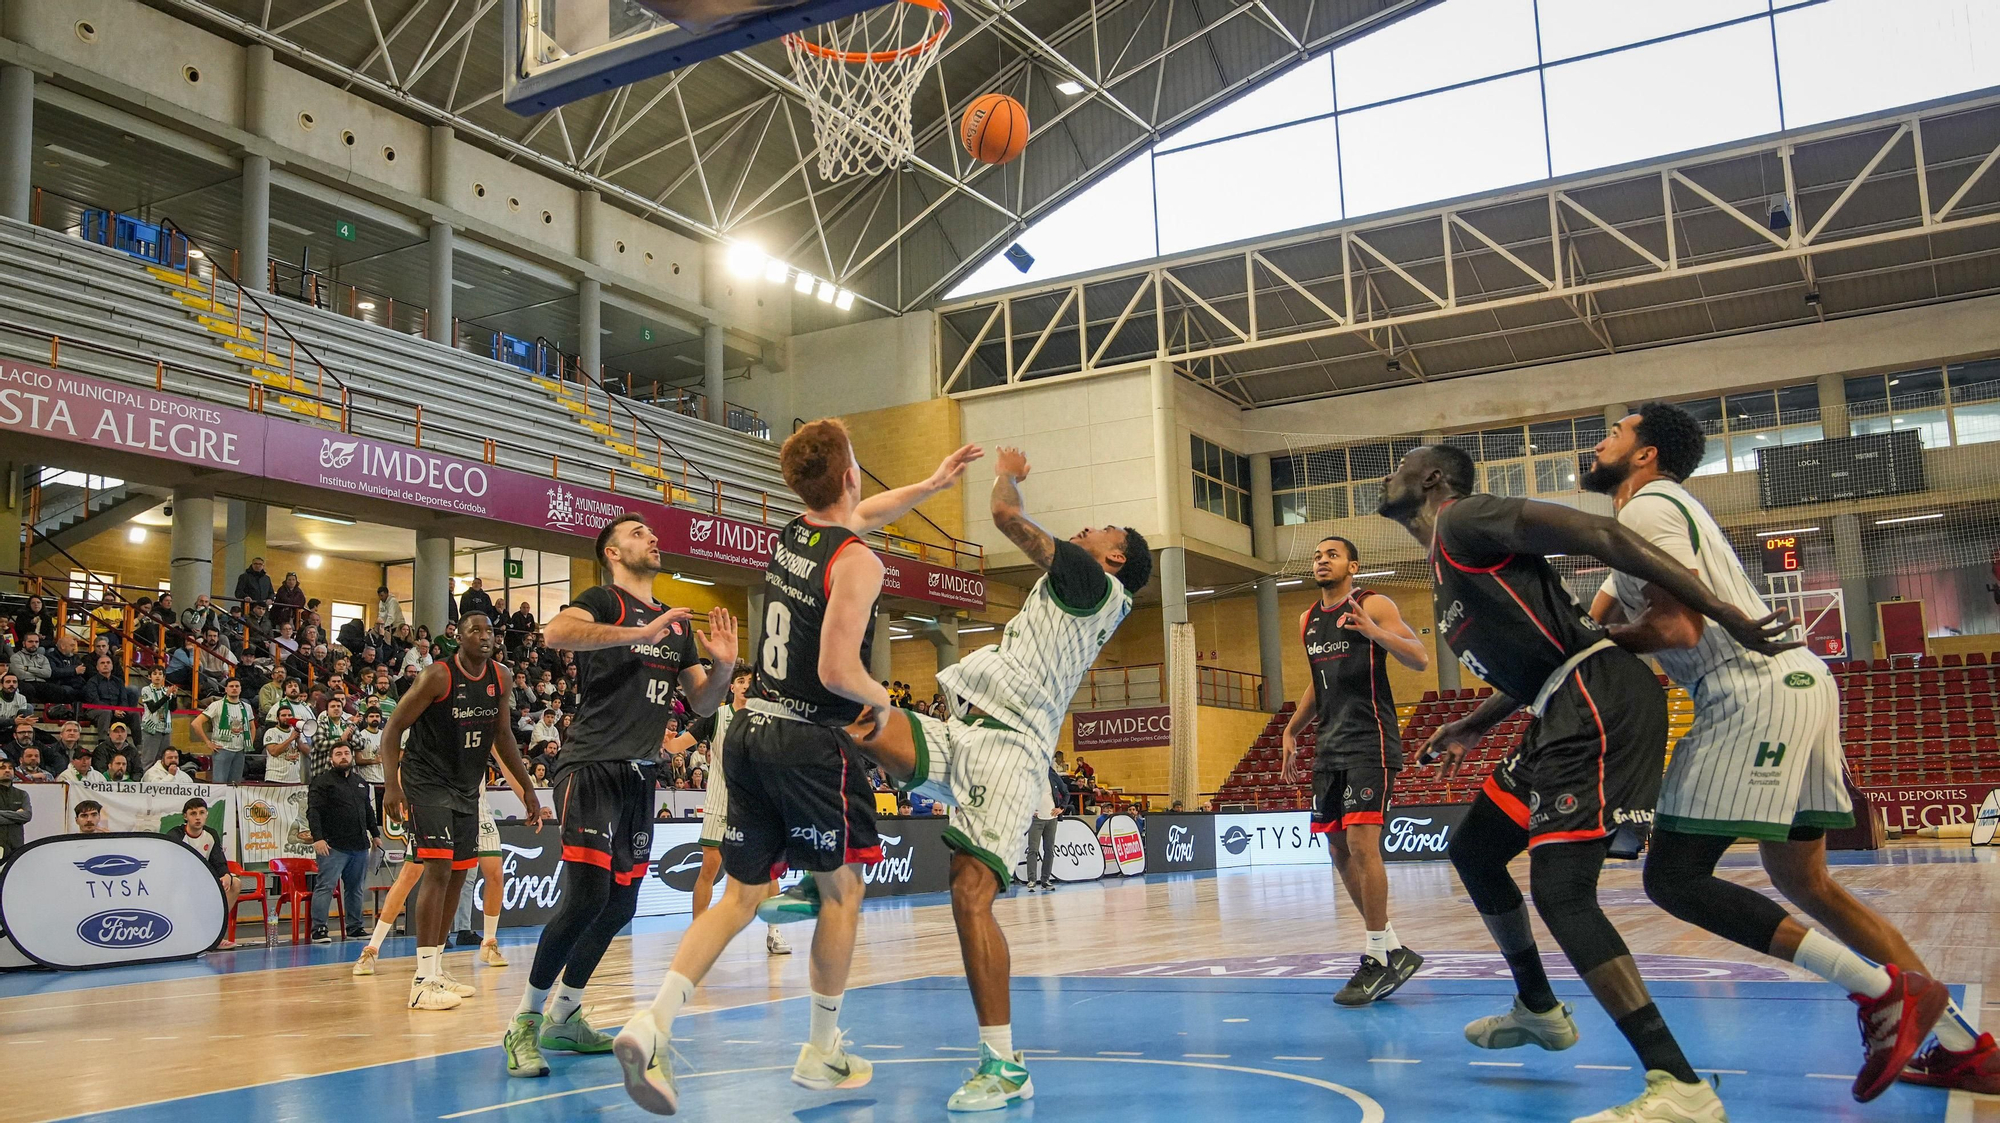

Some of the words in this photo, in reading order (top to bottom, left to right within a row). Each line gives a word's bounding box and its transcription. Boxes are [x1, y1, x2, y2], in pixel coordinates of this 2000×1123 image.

[340, 225, 349, 237] 4
[644, 329, 651, 340] 5
[57, 379, 145, 409] MUNICIPAL
[150, 398, 221, 425] DEPORTES
[91, 408, 241, 466] ALEGRE
[362, 443, 488, 498] IMDECO
[1797, 459, 1821, 467] LOCAL
[319, 474, 357, 490] Instituto
[358, 481, 401, 498] Municipal
[402, 490, 413, 500] de
[415, 492, 452, 508] Deportes
[453, 499, 487, 514] Córdoba
[575, 497, 625, 517] AYUNTAMIENTO
[575, 512, 584, 526] DE
[1767, 538, 1796, 550] 07:42
[689, 546, 713, 558] Instituto
[713, 550, 741, 564] Municipal
[741, 556, 748, 565] de
[1784, 551, 1798, 570] 6
[510, 562, 518, 576] D
[941, 573, 984, 597] IMDECO
[762, 601, 792, 681] 8
[1320, 669, 1328, 690] 1
[646, 679, 669, 706] 42
[451, 706, 499, 719] BieleGroup
[1100, 714, 1171, 736] IMDECO
[464, 731, 482, 749] 15
[1099, 737, 1123, 745] Municipal
[1130, 735, 1153, 743] Deportes
[84, 780, 113, 793] Peña
[117, 781, 136, 794] Las
[140, 783, 192, 797] Leyendas
[193, 786, 211, 798] del
[1899, 789, 1968, 802] DEPORTES
[1166, 824, 1195, 863] Ford
[1256, 826, 1321, 850] TYSA
[1384, 816, 1449, 853] Ford
[862, 833, 915, 885] Ford
[86, 879, 149, 898] TYSA
[97, 915, 155, 942] Ford
